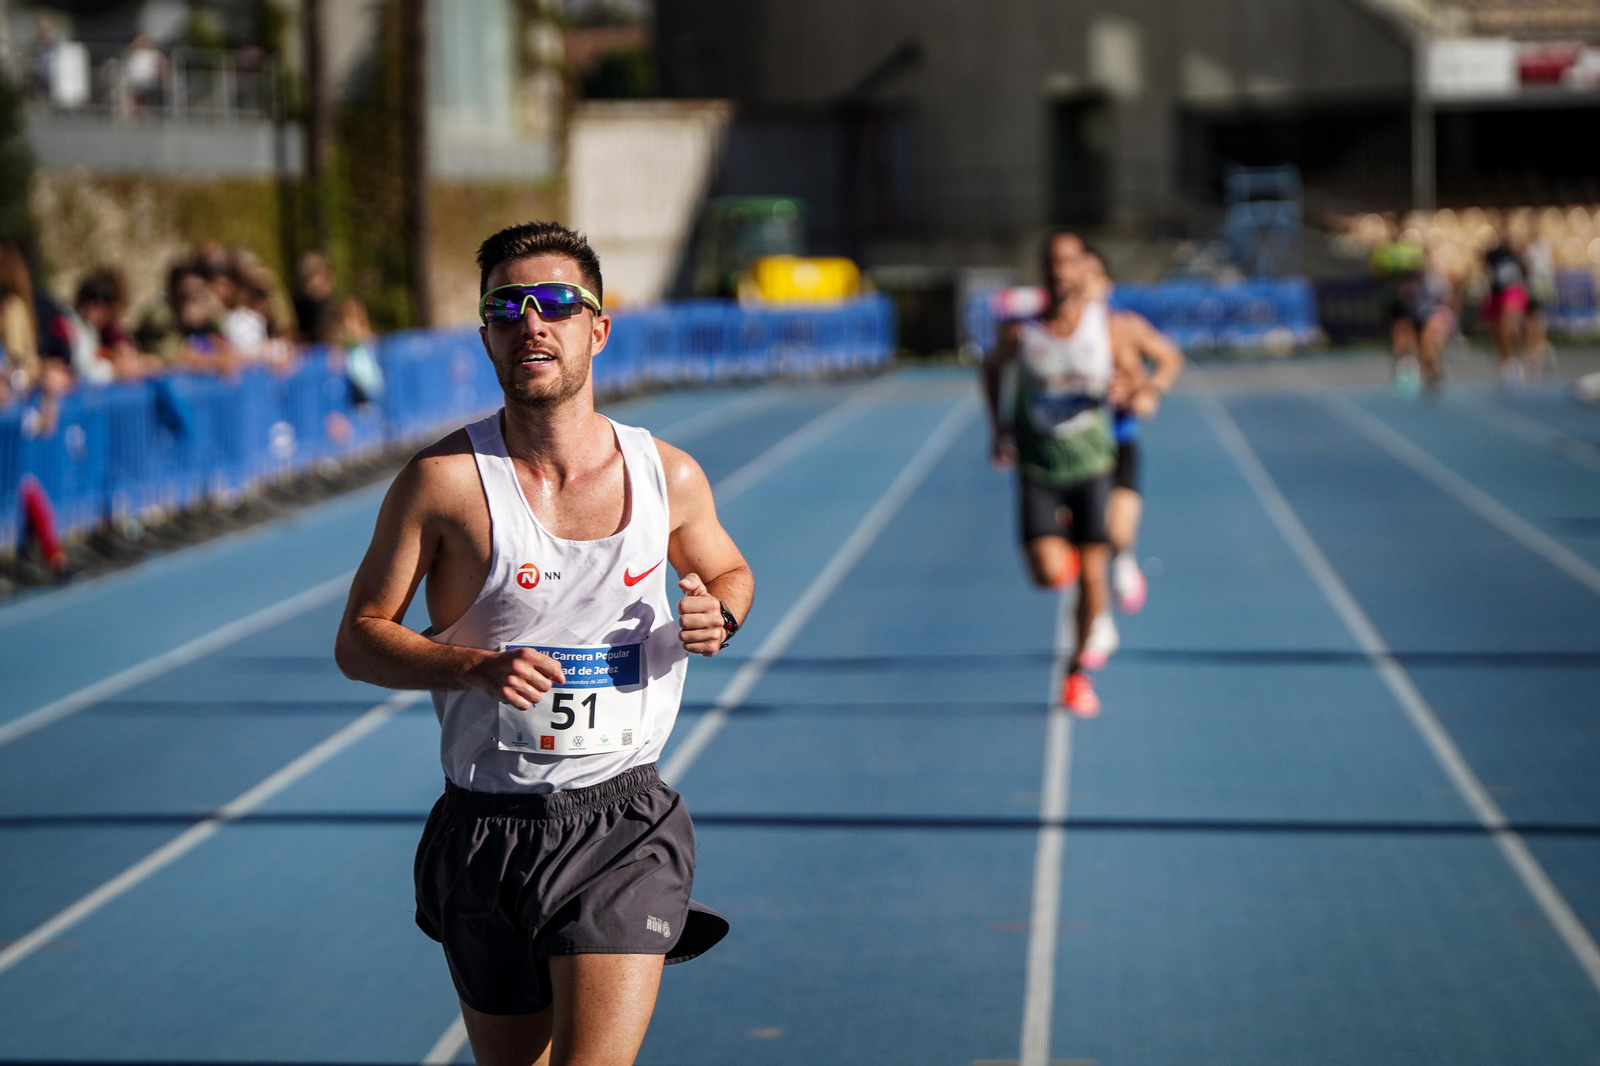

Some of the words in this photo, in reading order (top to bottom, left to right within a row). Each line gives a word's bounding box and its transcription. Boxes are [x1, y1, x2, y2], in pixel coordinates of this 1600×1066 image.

[544, 571, 561, 580] NN
[552, 651, 593, 661] Carrera
[595, 650, 630, 661] Popular
[578, 667, 592, 676] de
[593, 666, 619, 675] Jerez
[550, 693, 598, 730] 51
[646, 919, 662, 933] RUN
